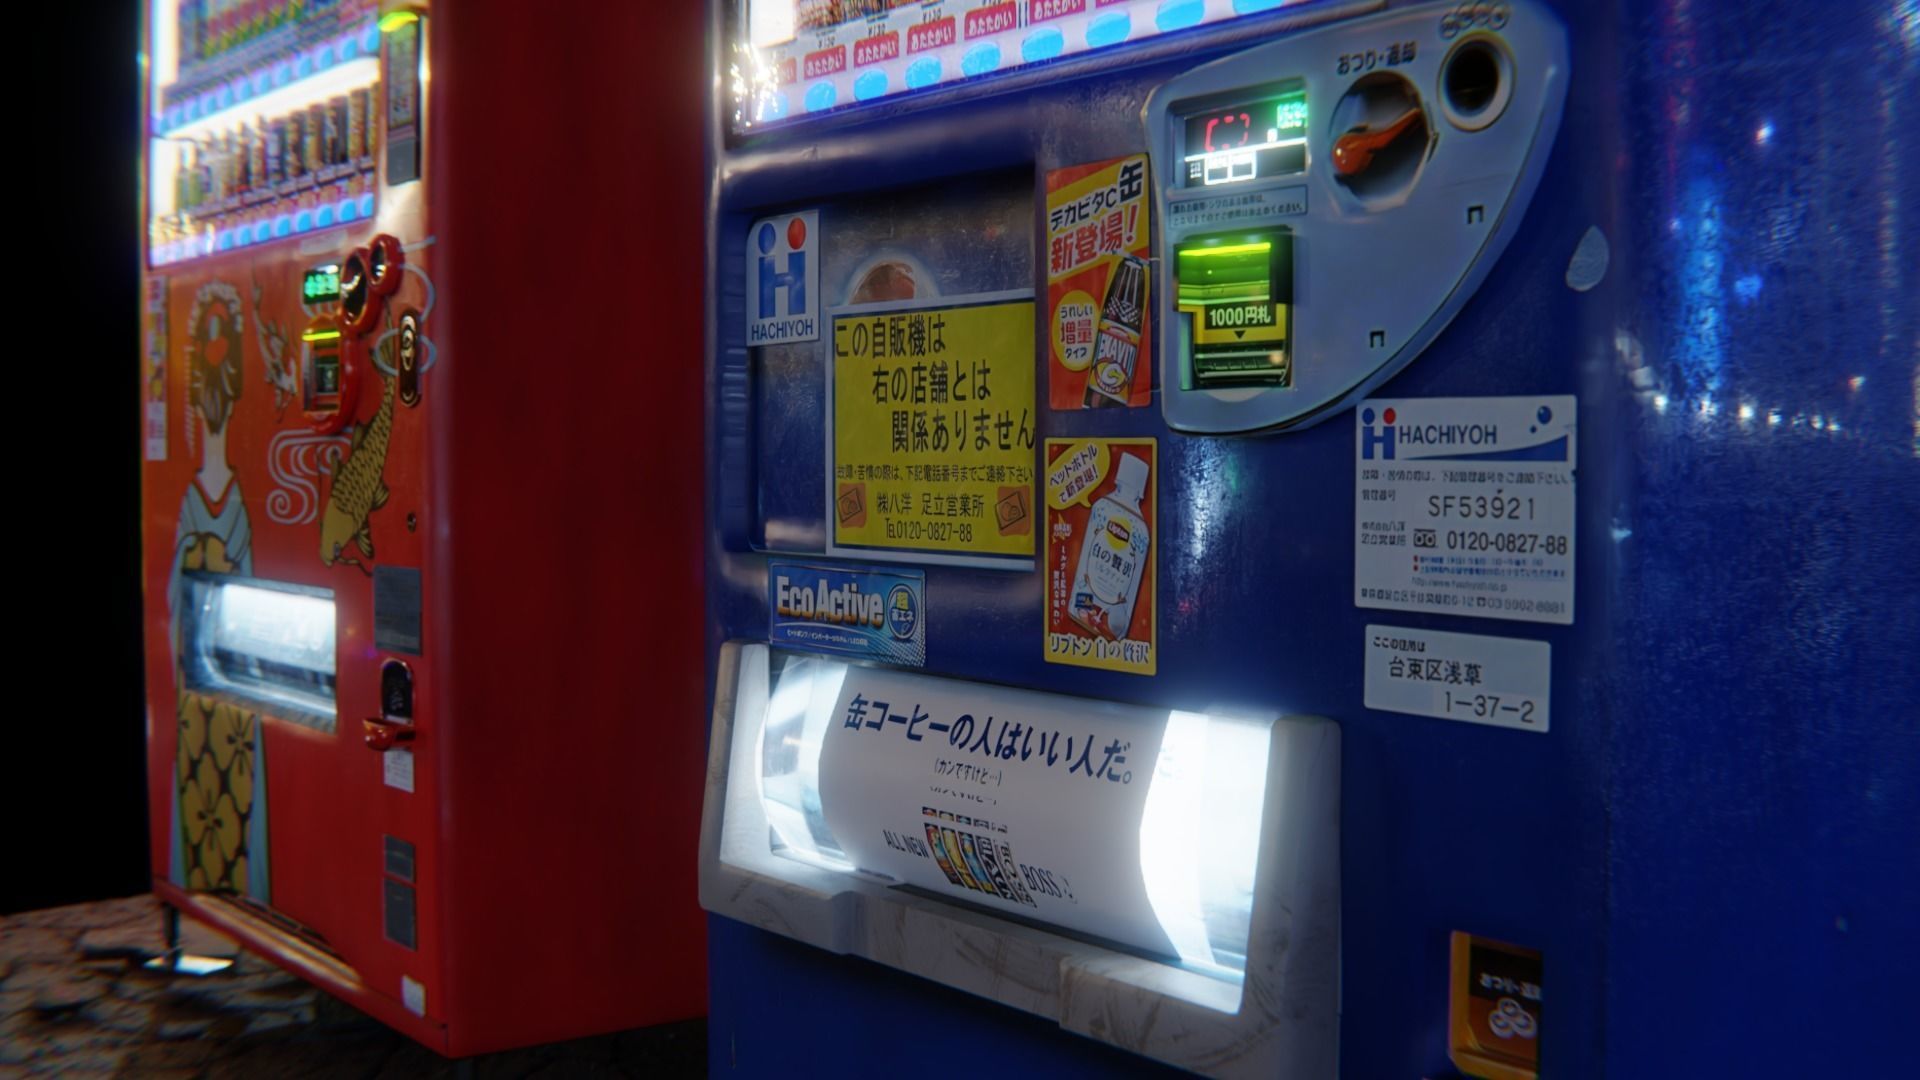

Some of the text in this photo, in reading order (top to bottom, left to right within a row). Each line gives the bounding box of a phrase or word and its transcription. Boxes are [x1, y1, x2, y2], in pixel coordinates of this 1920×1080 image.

[1051, 161, 1143, 232] デカビタC缶
[1060, 306, 1093, 319] うれしい
[1209, 305, 1271, 326] 1000円札
[751, 318, 813, 341] HACHIYOH
[835, 314, 946, 358] この自販機は
[1060, 319, 1093, 345] 増量
[1065, 347, 1088, 359] タイプ
[872, 359, 991, 405] 右の店舗とは
[891, 407, 1036, 453] 関係ありません
[1399, 423, 1498, 446] HACHIYOH
[1050, 444, 1098, 487] ペットボトル
[921, 492, 985, 519] 足立営業所
[1428, 494, 1535, 520] SF53921
[1446, 530, 1568, 555] 0120-0827-88
[776, 575, 885, 628] EcoActive
[1388, 655, 1482, 686] 台東区浅草
[1445, 691, 1536, 724] 1-37-2
[843, 692, 1133, 785] 缶コーヒーの人はいい人だ。
[883, 829, 930, 859] ALL NEW
[1019, 863, 1063, 898] BOSS
